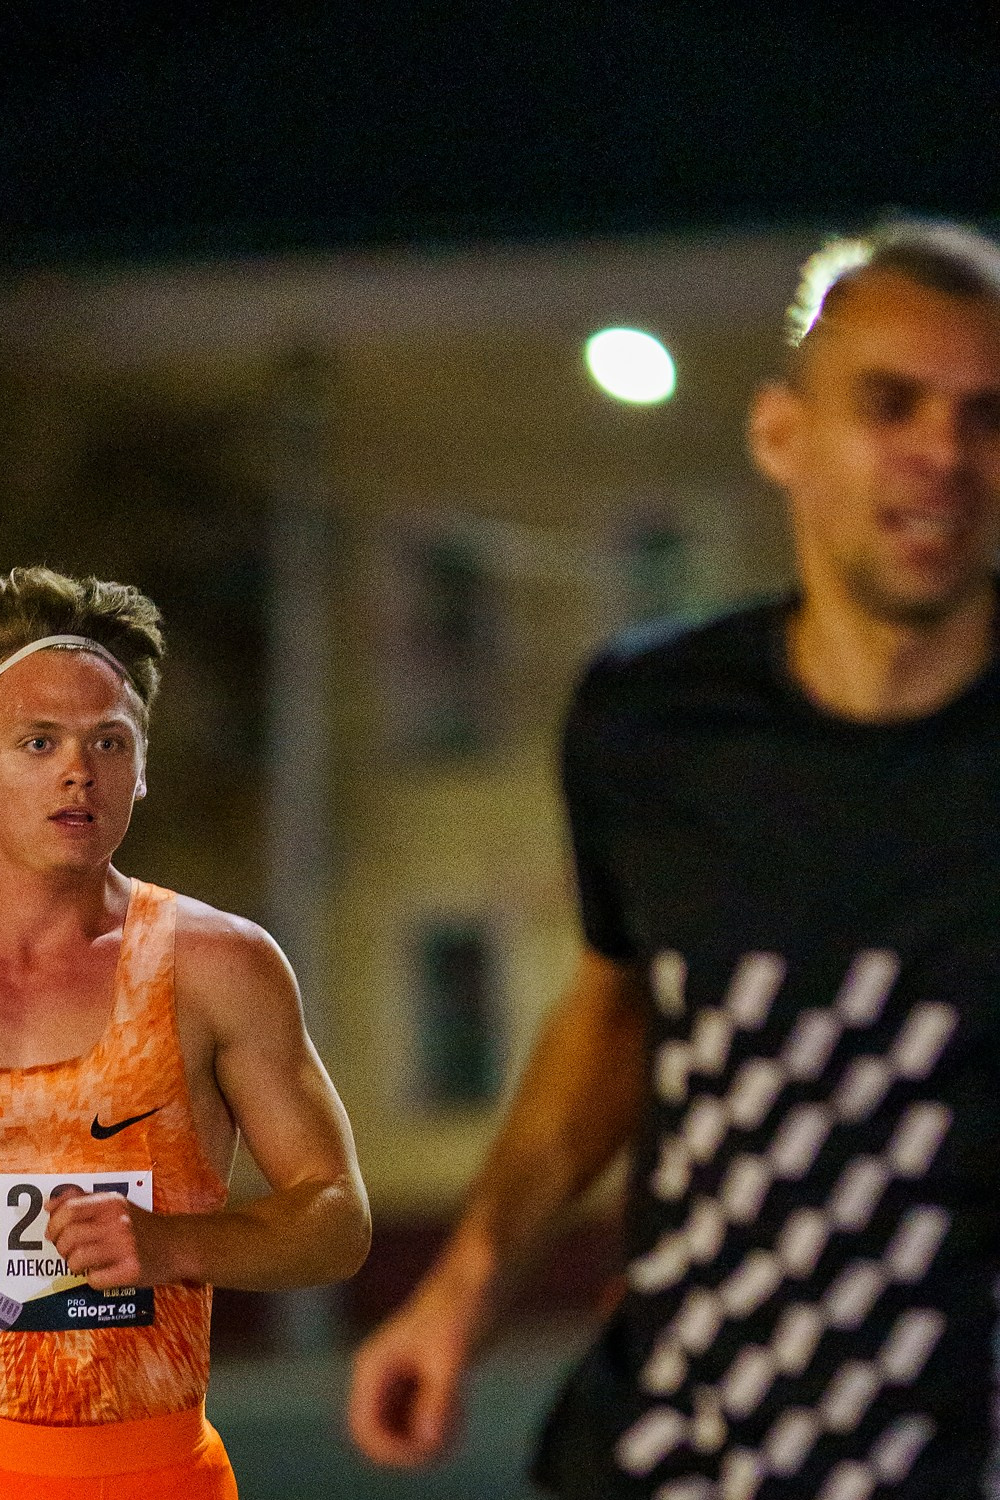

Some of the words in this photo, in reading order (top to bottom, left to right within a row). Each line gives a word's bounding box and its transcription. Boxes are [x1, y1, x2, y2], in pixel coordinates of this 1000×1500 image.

[67, 1298, 86, 1307] PRO
[67, 1304, 116, 1318] СПОРТ
[118, 1303, 136, 1315] 40
